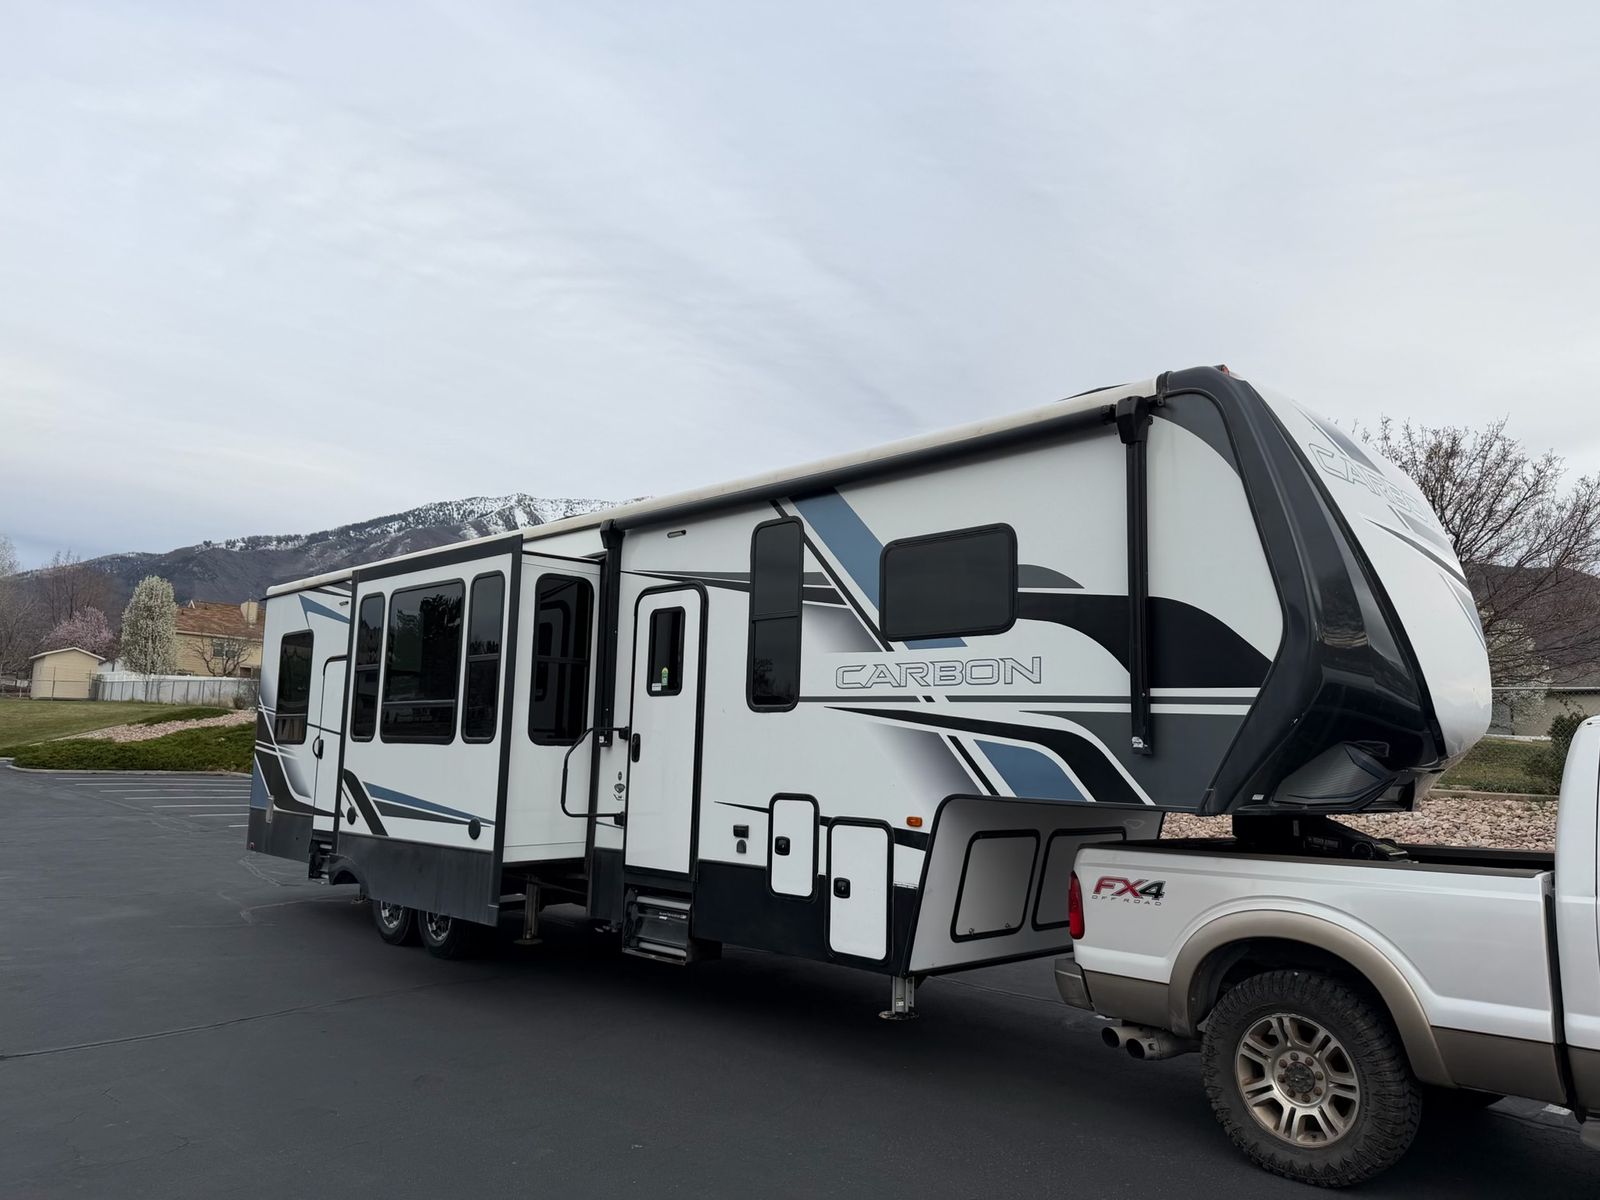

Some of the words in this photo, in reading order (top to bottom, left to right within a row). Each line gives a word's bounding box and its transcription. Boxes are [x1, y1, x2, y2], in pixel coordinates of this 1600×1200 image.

[835, 656, 1042, 690] CARBON
[1093, 876, 1166, 901] FX4
[1123, 898, 1162, 906] ROAD
